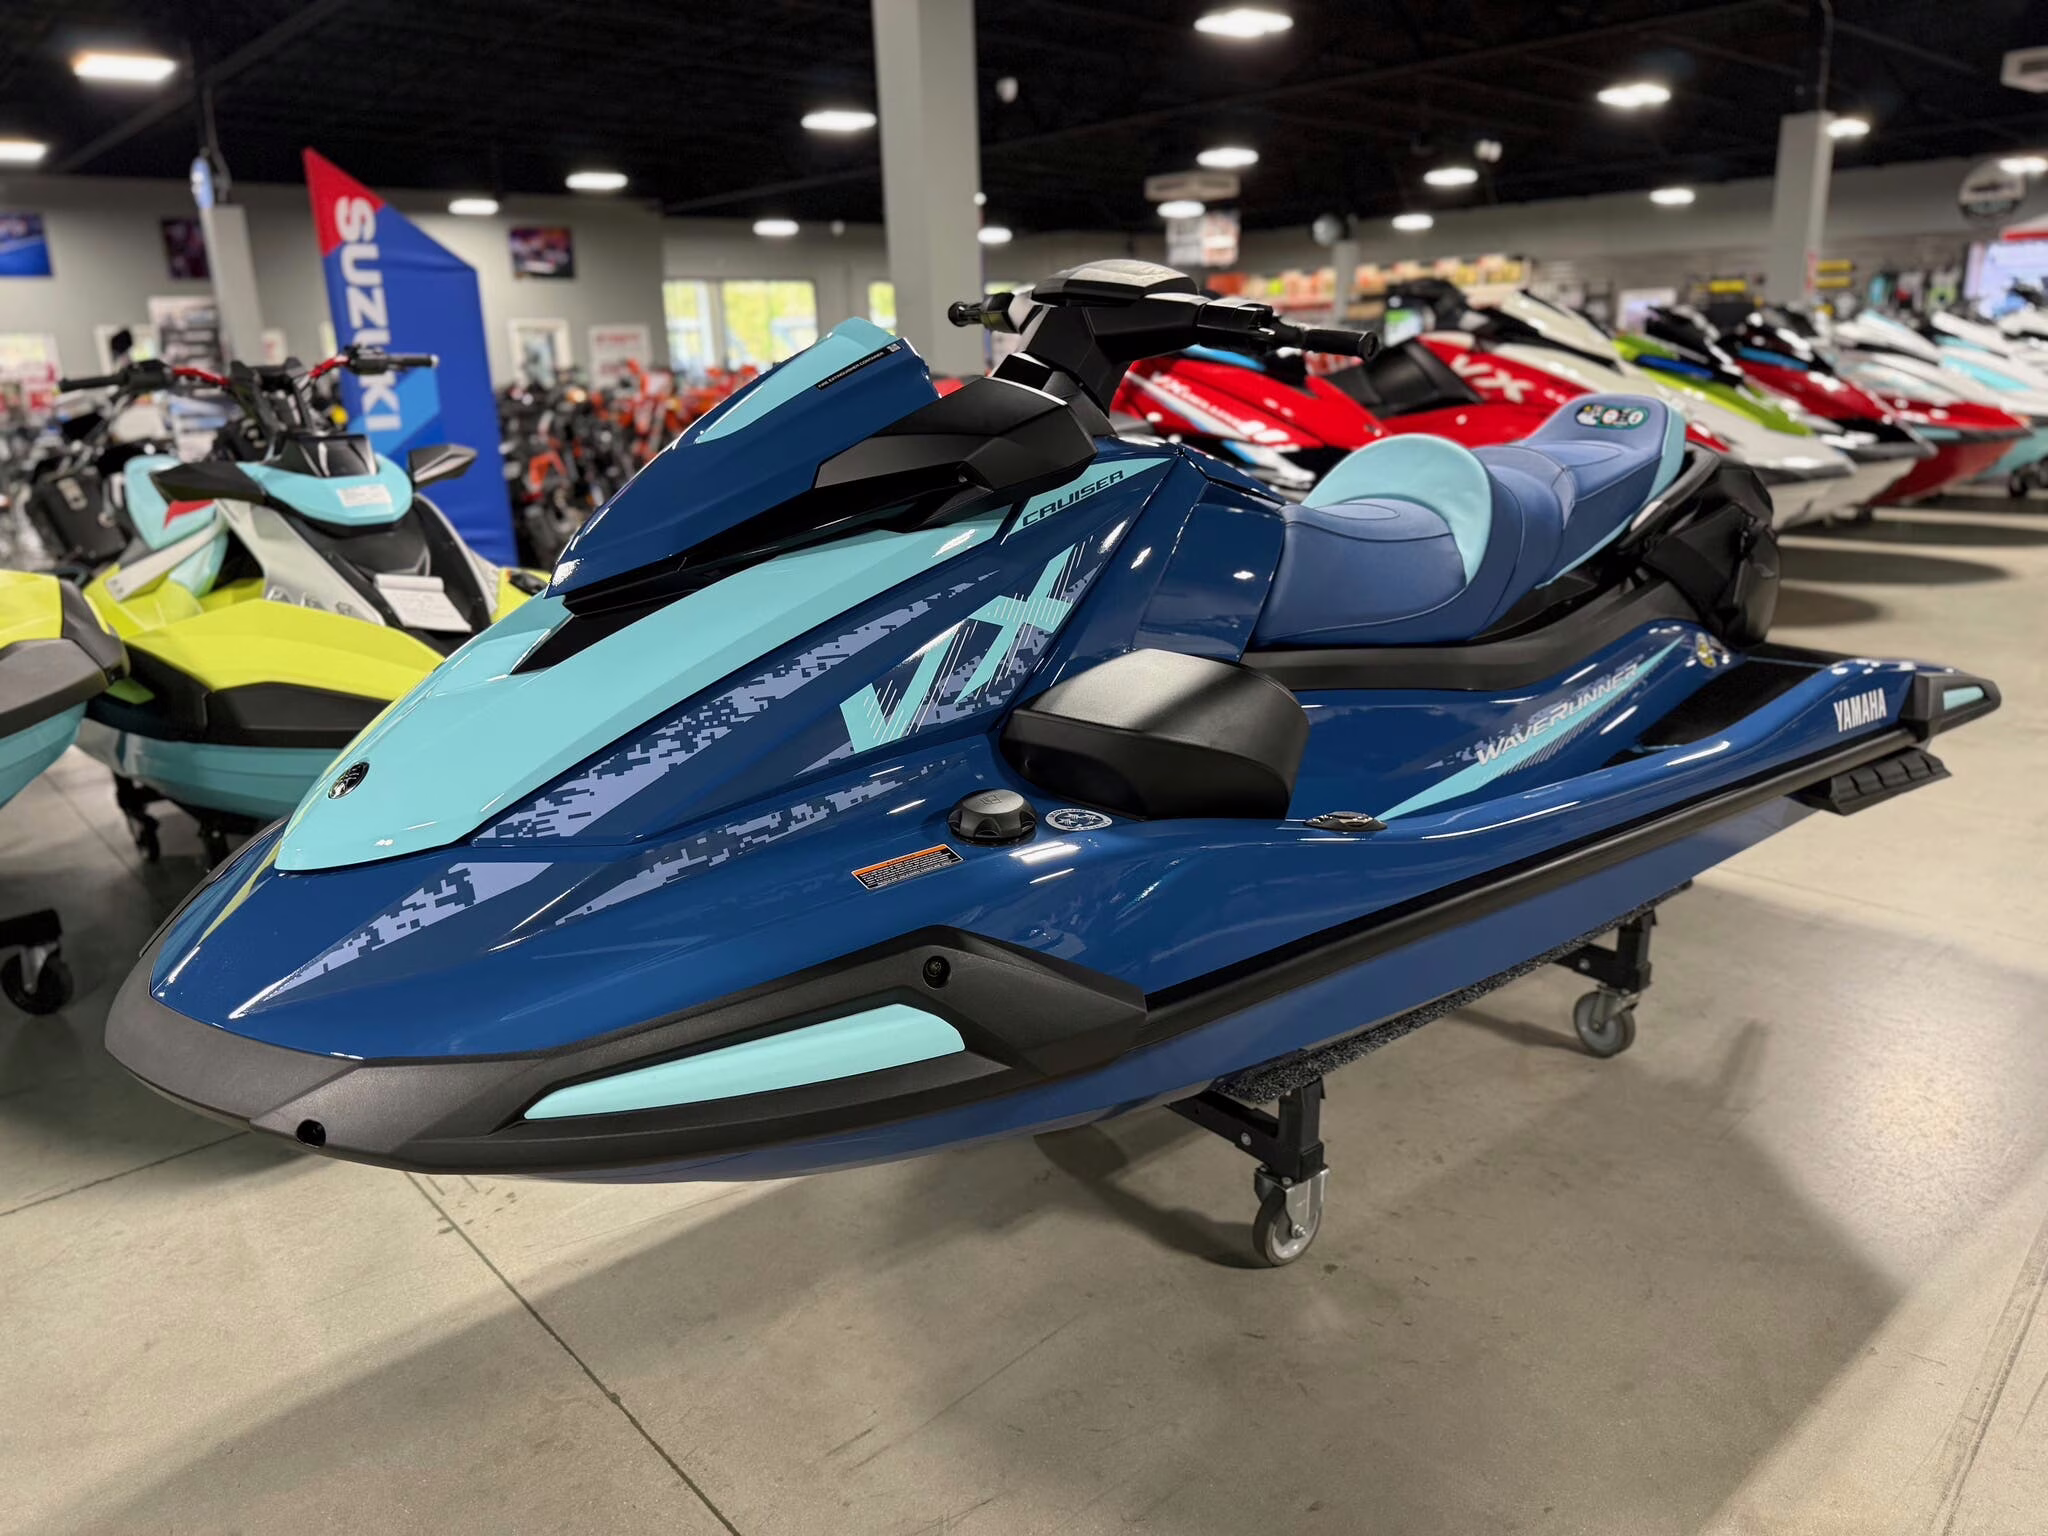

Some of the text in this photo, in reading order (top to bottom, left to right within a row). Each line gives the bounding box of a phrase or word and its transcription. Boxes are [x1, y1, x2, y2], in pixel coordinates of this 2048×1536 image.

[1451, 353, 1535, 404] VX
[1022, 469, 1125, 527] CRUISER
[839, 543, 1074, 755] VX
[1475, 662, 1638, 766] WAVERUNNER
[1833, 687, 1887, 733] YAMAHA
